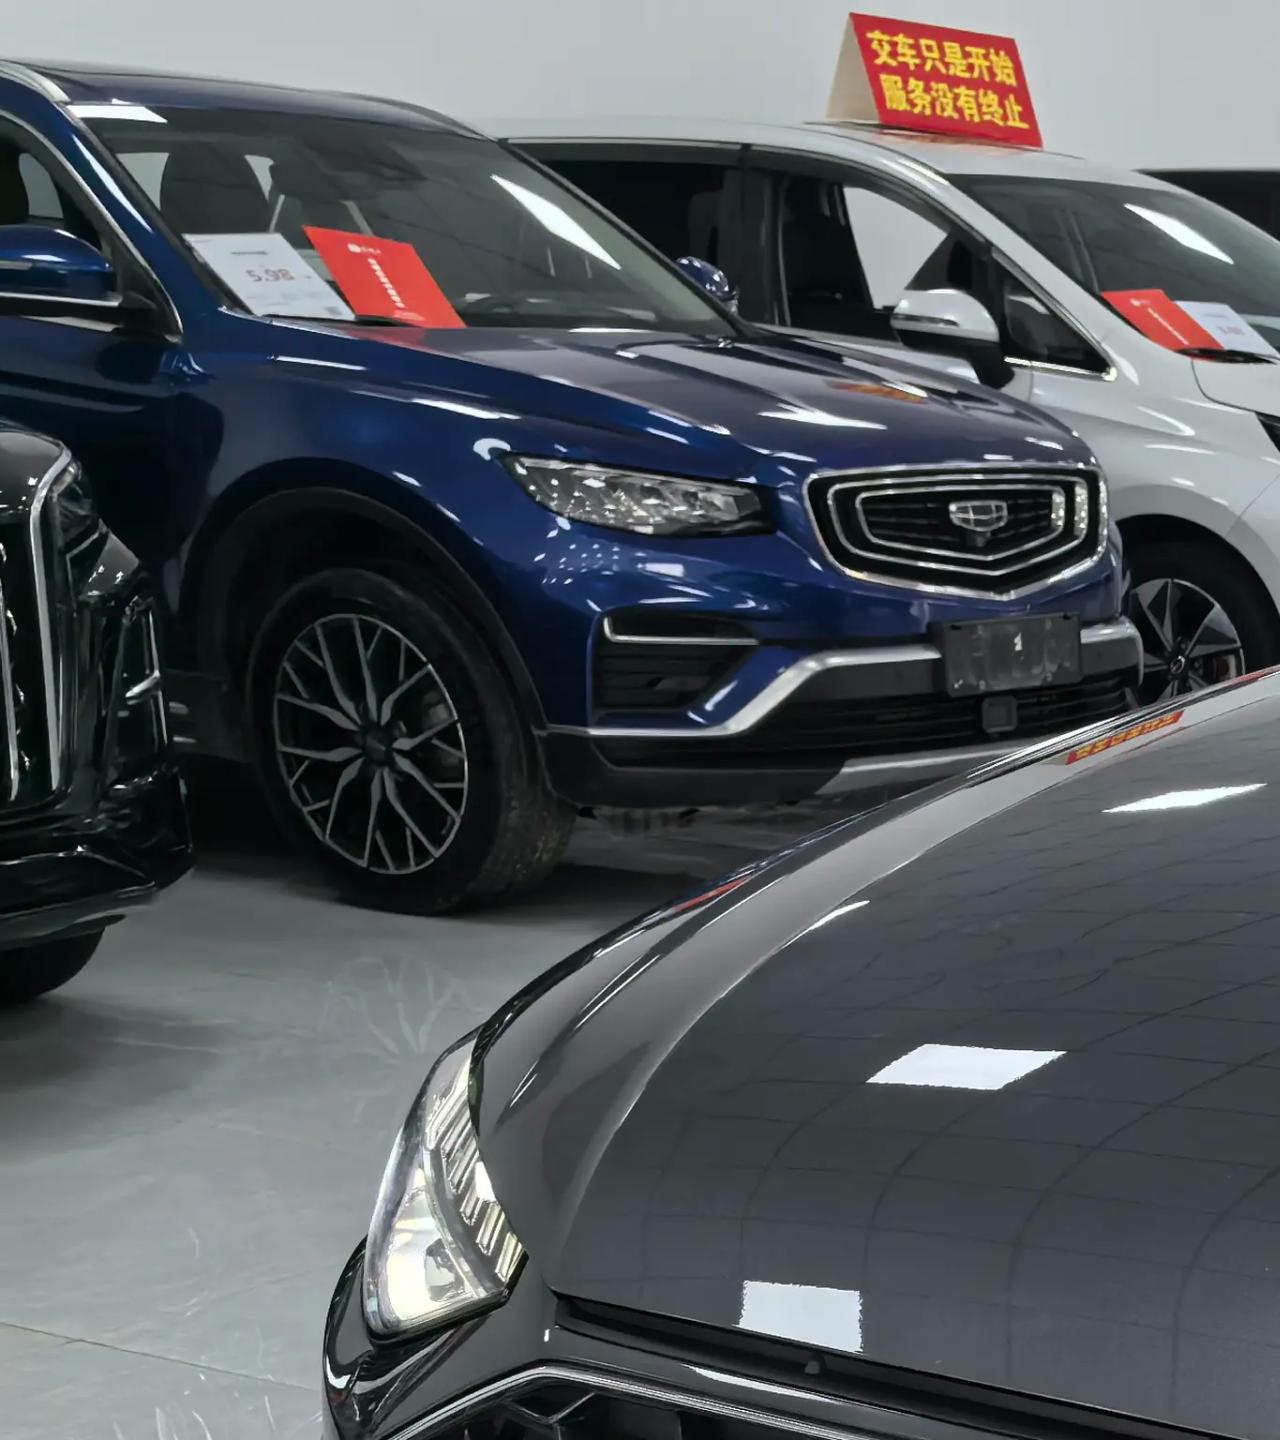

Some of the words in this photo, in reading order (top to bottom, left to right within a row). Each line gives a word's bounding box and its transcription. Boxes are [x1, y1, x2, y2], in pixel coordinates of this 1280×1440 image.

[866, 30, 1018, 87] 交车只是开始
[879, 73, 1030, 129] 服务没有终止
